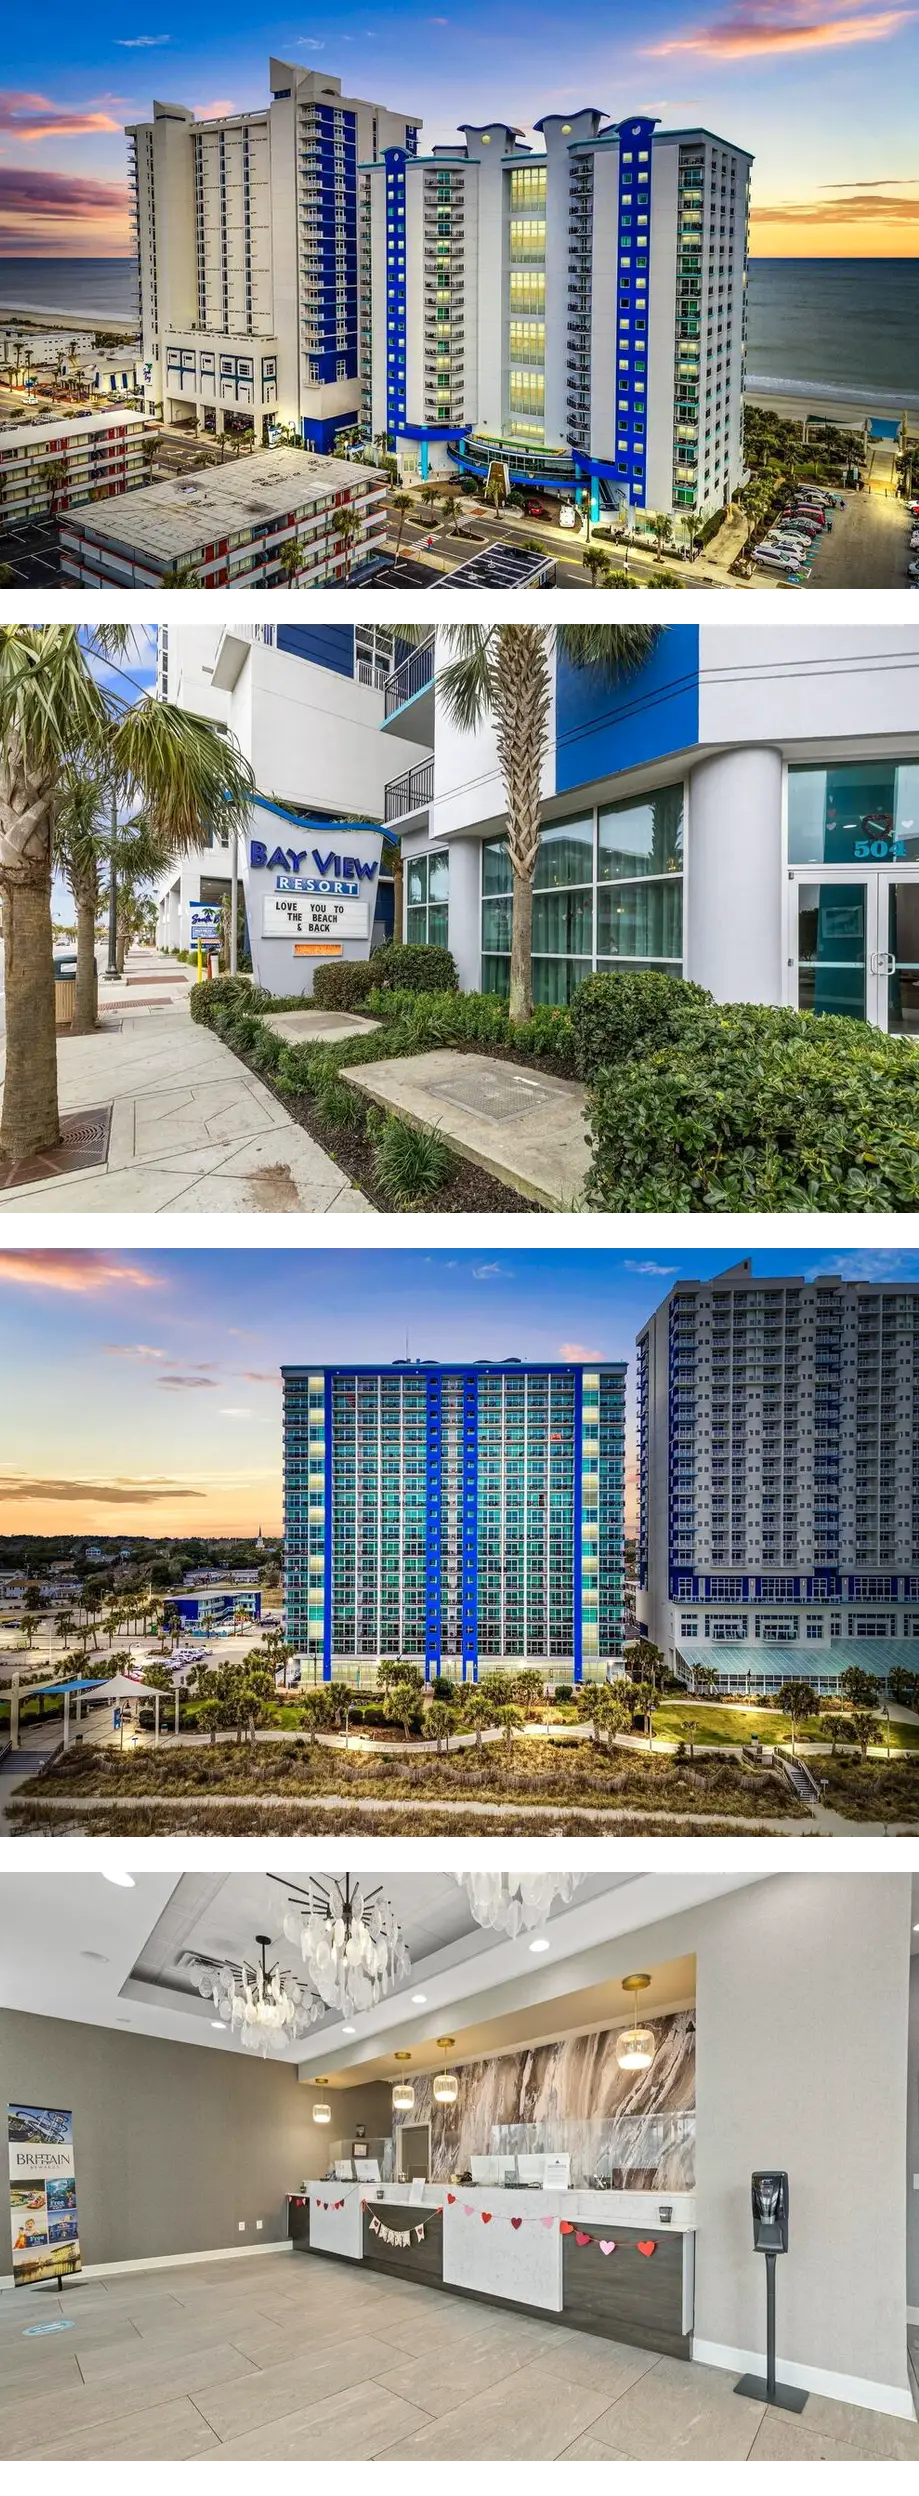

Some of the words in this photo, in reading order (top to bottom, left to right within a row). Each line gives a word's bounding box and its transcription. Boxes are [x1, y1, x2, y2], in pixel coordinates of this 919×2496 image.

[854, 840, 907, 857] 504
[250, 840, 307, 872] BAY
[312, 849, 378, 880] VIEW
[280, 877, 355, 894] RESORT
[276, 901, 297, 911] LOVE
[310, 903, 327, 913] YOU
[334, 905, 344, 914] TO
[287, 912, 302, 921] THE
[312, 913, 338, 923] BEACH
[297, 922, 302, 931] &
[308, 923, 330, 932] BACK
